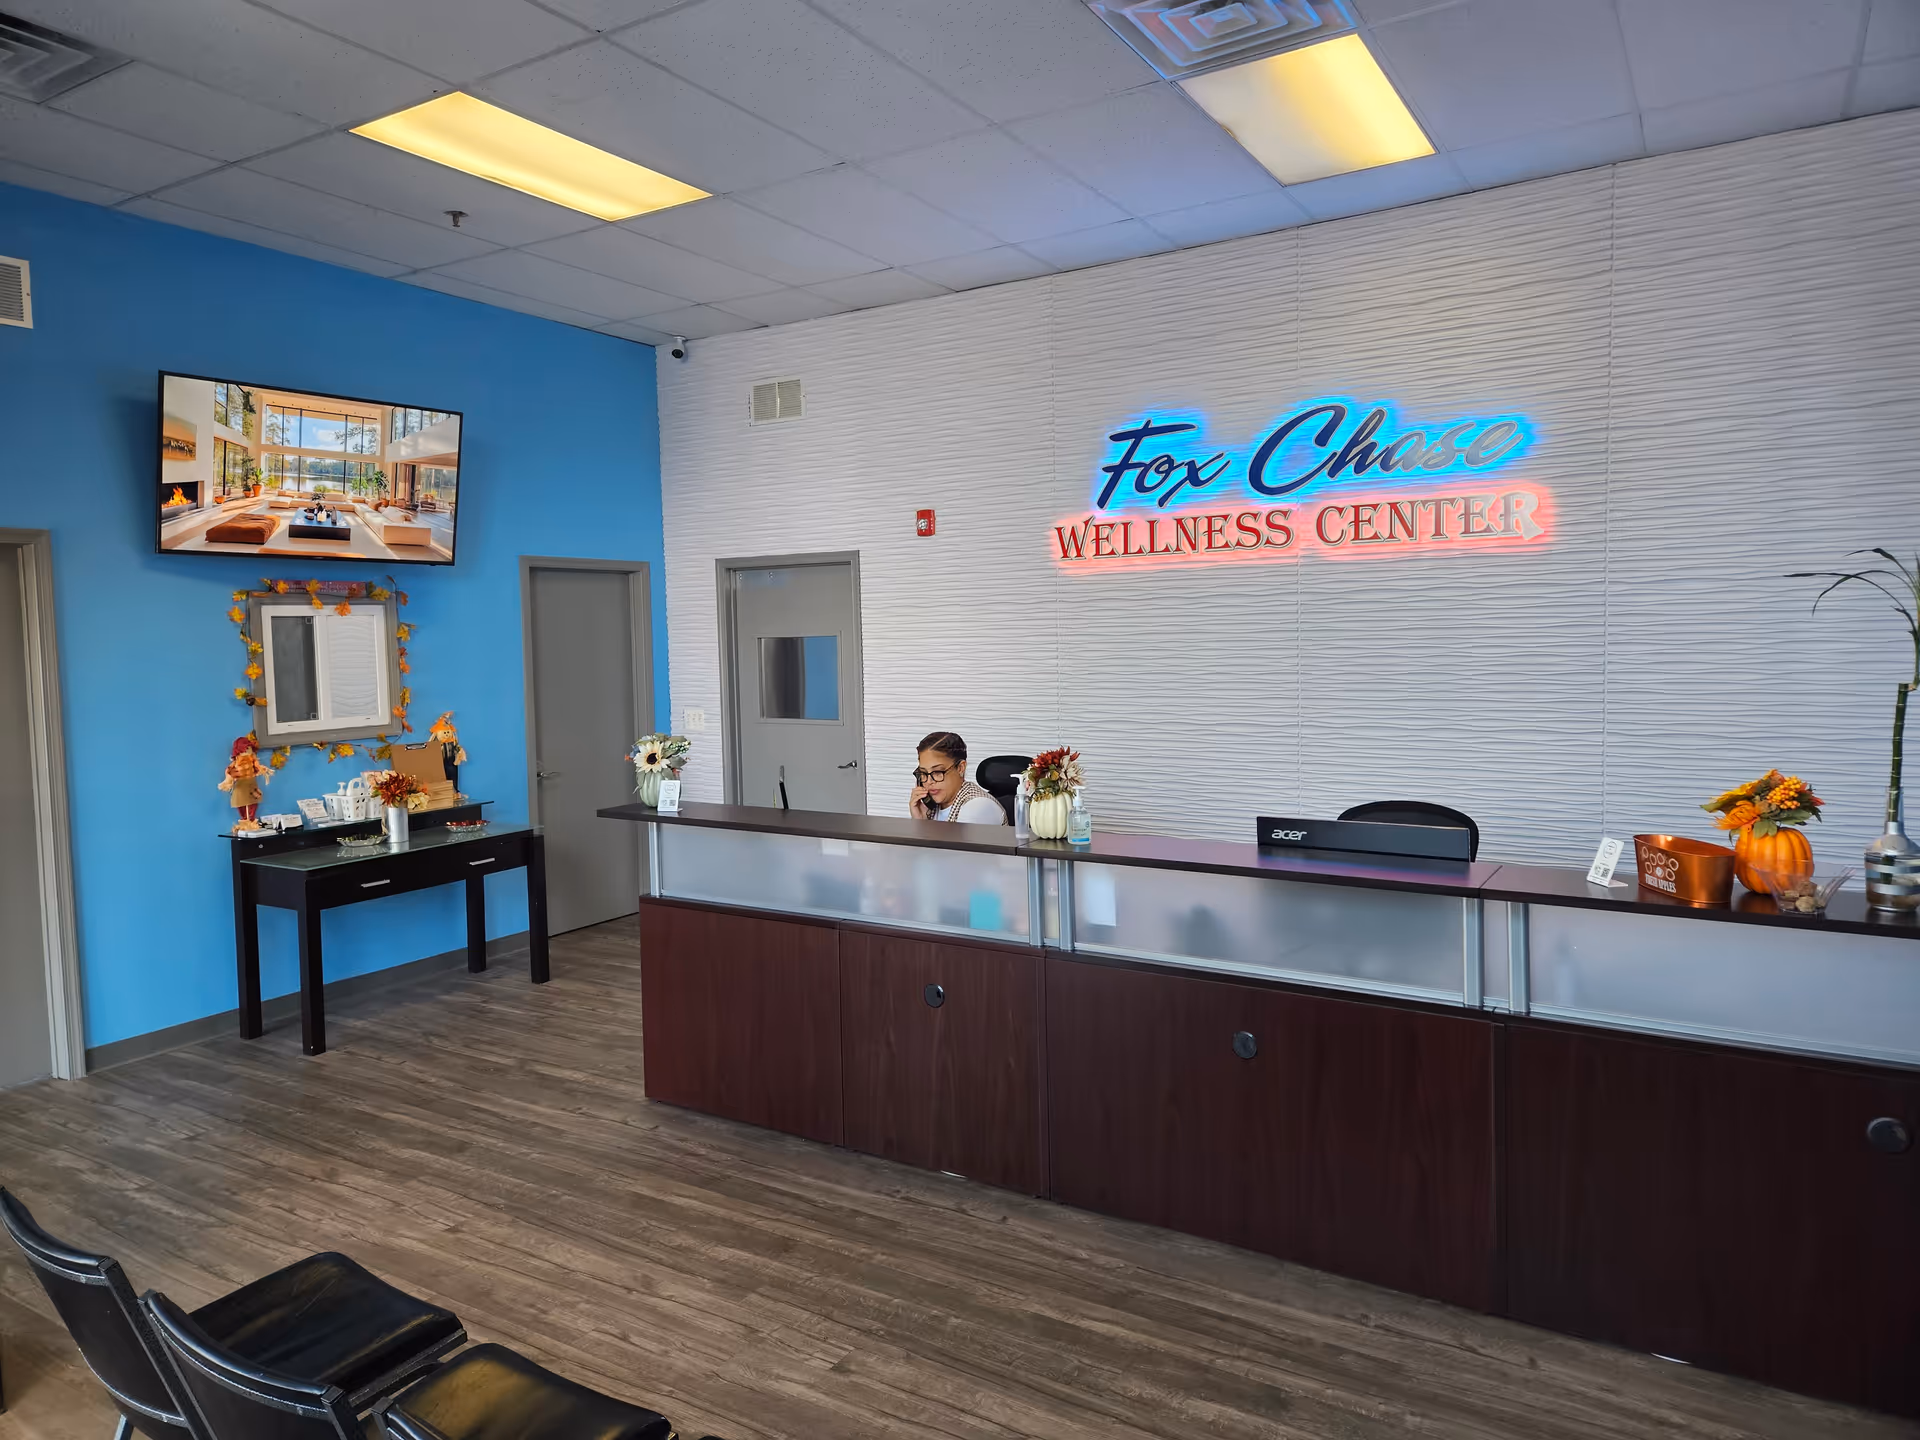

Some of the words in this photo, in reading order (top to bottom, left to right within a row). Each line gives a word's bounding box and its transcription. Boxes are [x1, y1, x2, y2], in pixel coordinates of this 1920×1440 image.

[1097, 418, 1231, 509] Fox
[1248, 403, 1523, 496] Chase
[1055, 511, 1294, 561] WELLNESS
[1315, 491, 1544, 546] CENTER
[1272, 829, 1308, 841] acer
